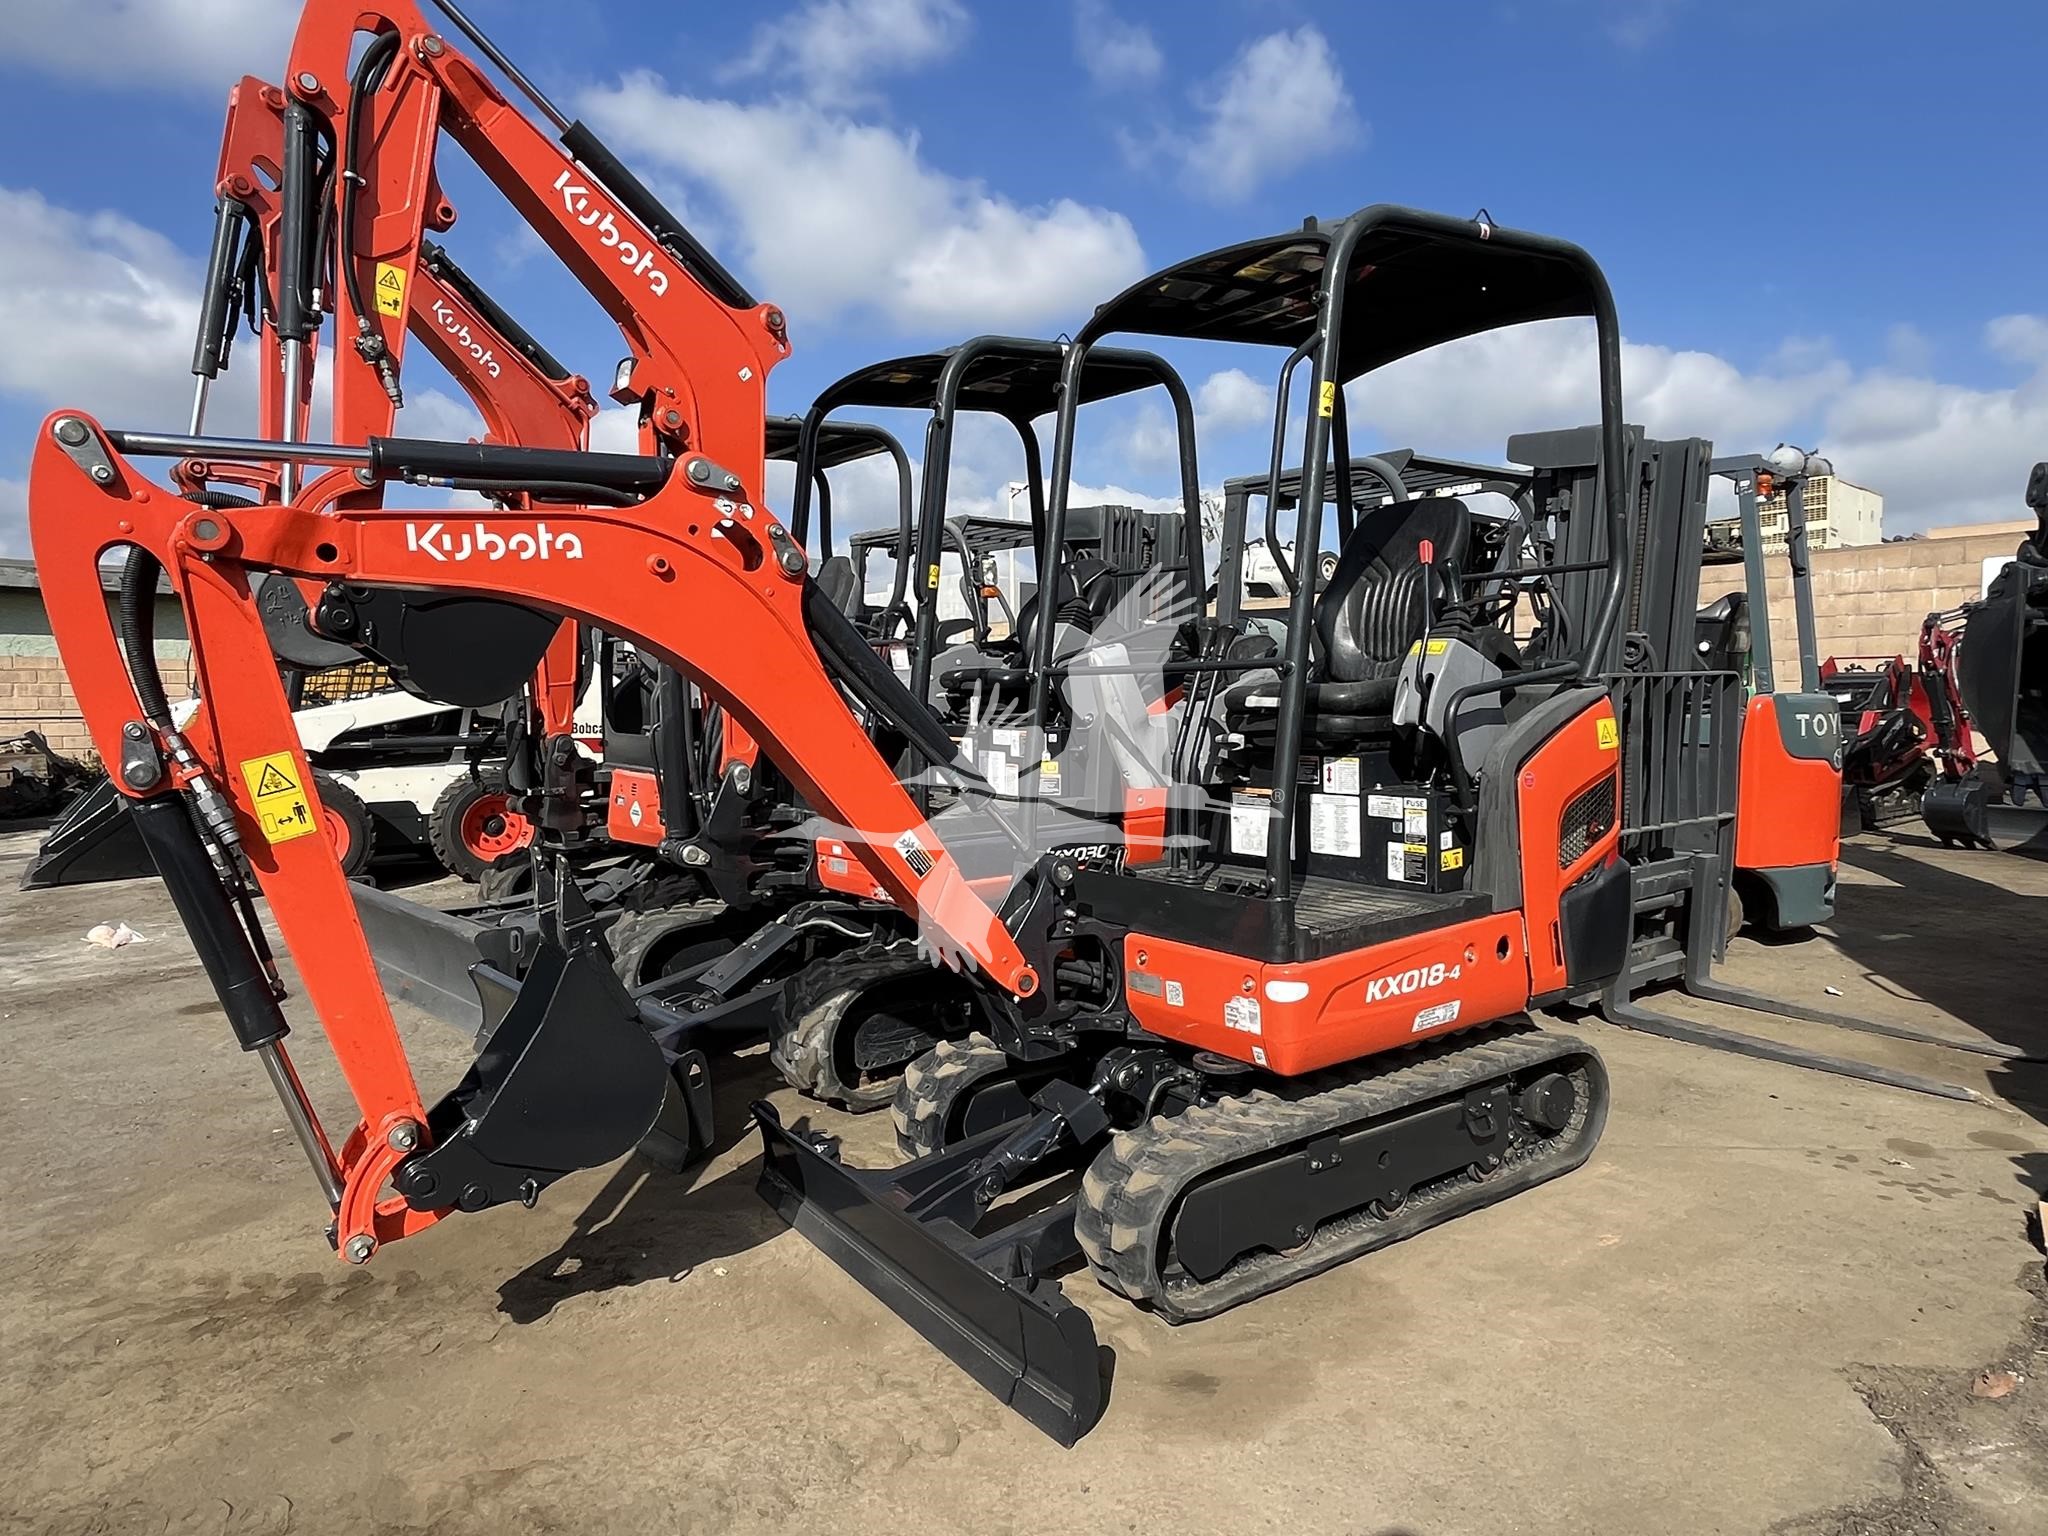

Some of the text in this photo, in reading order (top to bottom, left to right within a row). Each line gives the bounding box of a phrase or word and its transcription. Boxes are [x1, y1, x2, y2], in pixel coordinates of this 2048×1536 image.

[553, 170, 669, 297] Kubota
[432, 299, 500, 378] Kubota
[405, 523, 583, 561] Kubota
[1795, 713, 1841, 737] TOY
[1406, 800, 1425, 808] FUSE
[1365, 963, 1461, 1004] KX018-4
